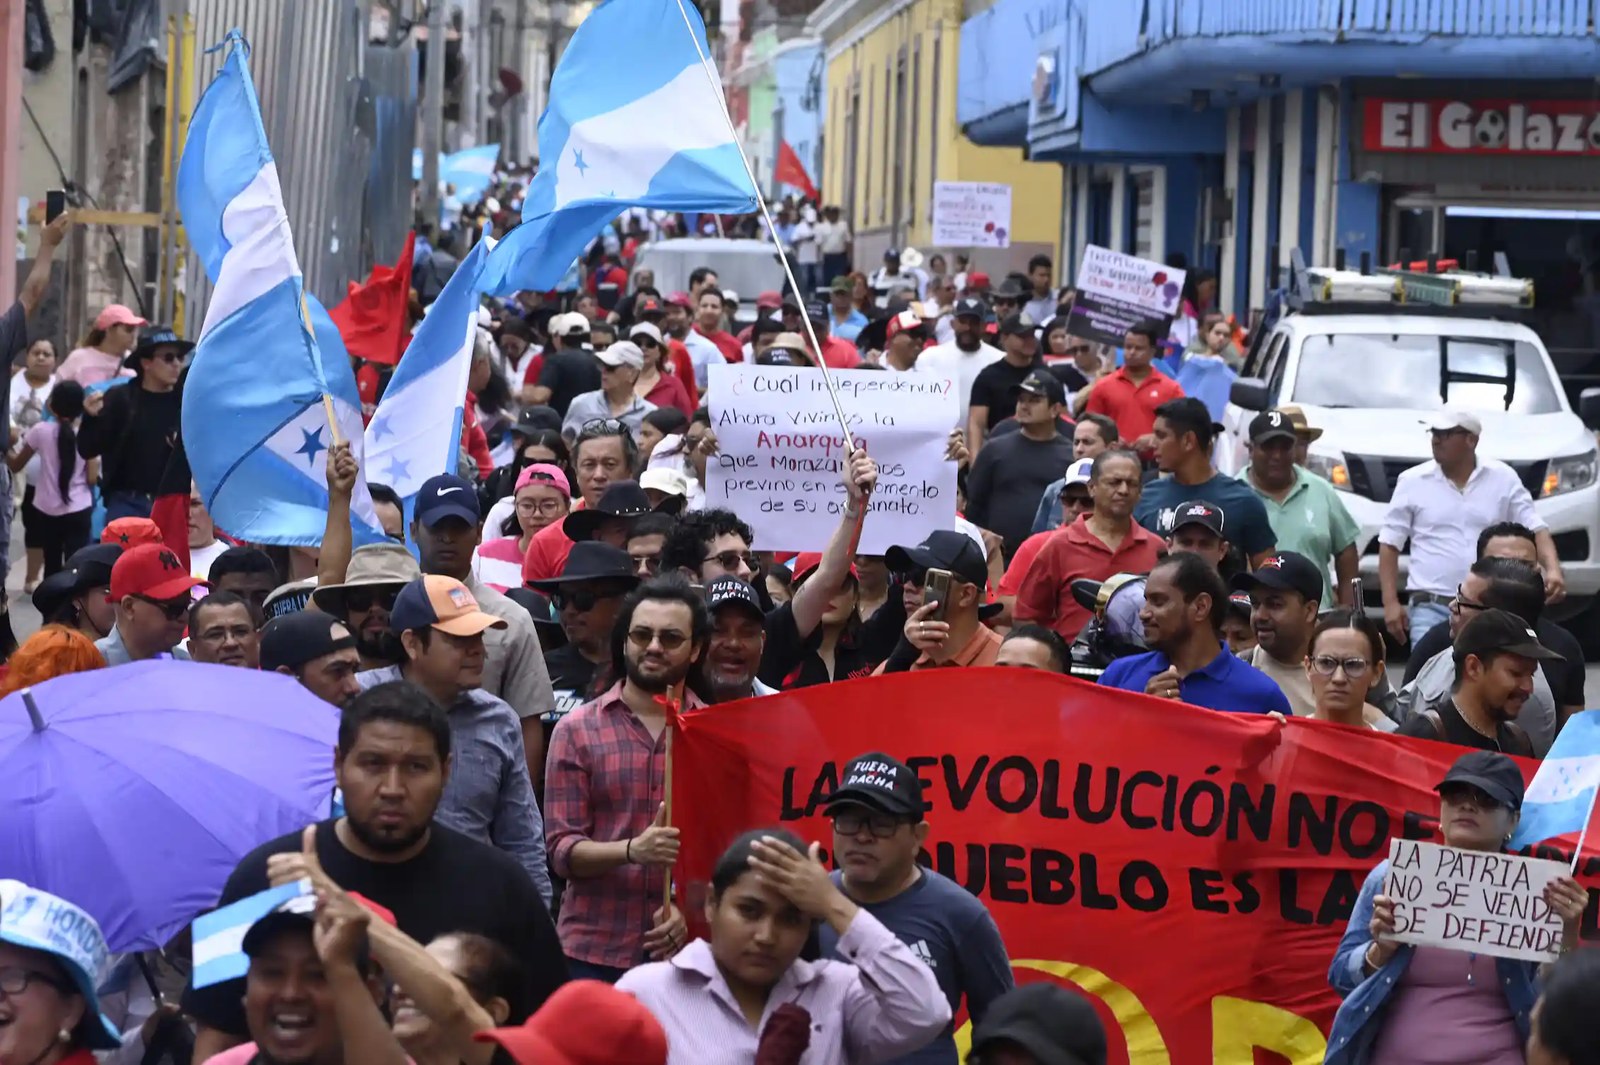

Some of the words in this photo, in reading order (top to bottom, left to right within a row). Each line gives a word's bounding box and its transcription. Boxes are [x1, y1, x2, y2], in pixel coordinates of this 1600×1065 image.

[1380, 102, 1428, 148] El
[719, 408, 777, 427] Ahora
[875, 412, 897, 427] la
[724, 478, 796, 499] previno
[802, 481, 826, 492] en
[874, 480, 940, 499] omento
[760, 497, 784, 512] de
[793, 499, 817, 512] su
[711, 581, 750, 593] FUERA
[853, 761, 897, 777] FUERA
[904, 752, 1276, 845] EVOLUCIÓN
[1287, 791, 1390, 858] NO
[1392, 841, 1420, 870] LA
[1435, 848, 1530, 891] PATRIA
[1189, 867, 1261, 914] ES
[1389, 872, 1422, 902] NO
[1431, 881, 1470, 908] SE
[1482, 888, 1562, 925] VENDE
[1392, 902, 1427, 934] SE
[1442, 912, 1563, 954] DEFIENDE
